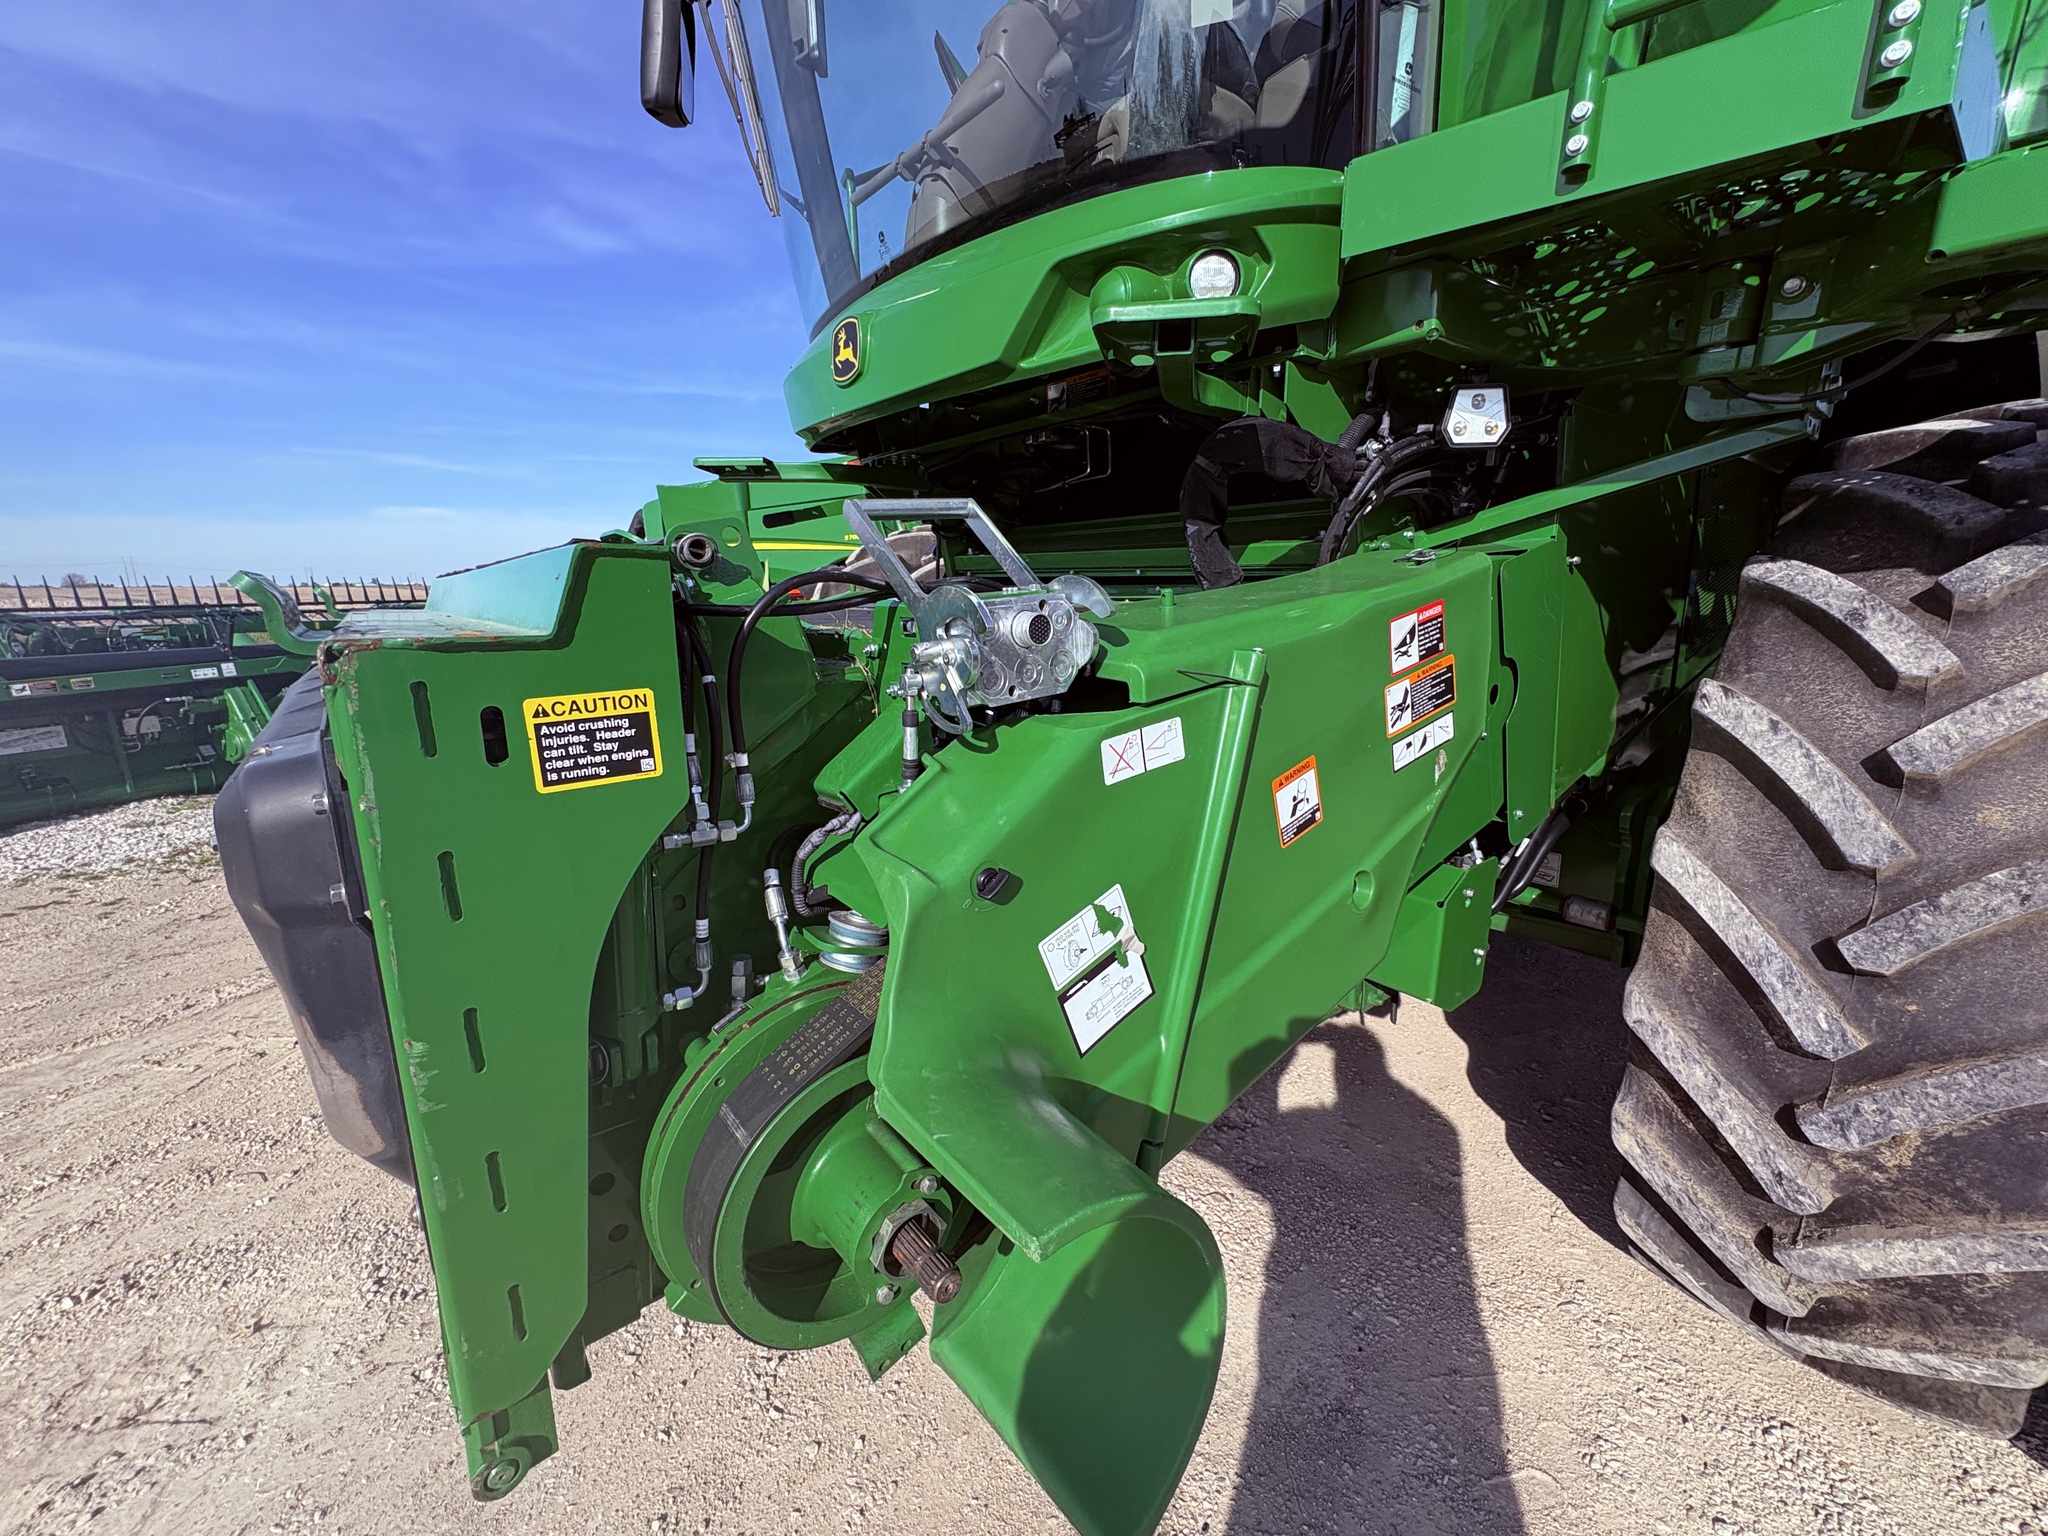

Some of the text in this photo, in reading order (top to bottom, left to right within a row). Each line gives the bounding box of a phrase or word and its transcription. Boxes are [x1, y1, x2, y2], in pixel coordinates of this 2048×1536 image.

[1421, 604, 1442, 618] DANGER
[1421, 661, 1443, 674] WARNING
[550, 693, 648, 716] CAUTION
[540, 718, 630, 736] Avoid crushing
[541, 728, 636, 748] injuries. Header
[543, 742, 620, 758] can tilt. Stay
[545, 748, 649, 770] clear when engine
[546, 766, 610, 781] is running.
[1284, 761, 1310, 782] WARNING
